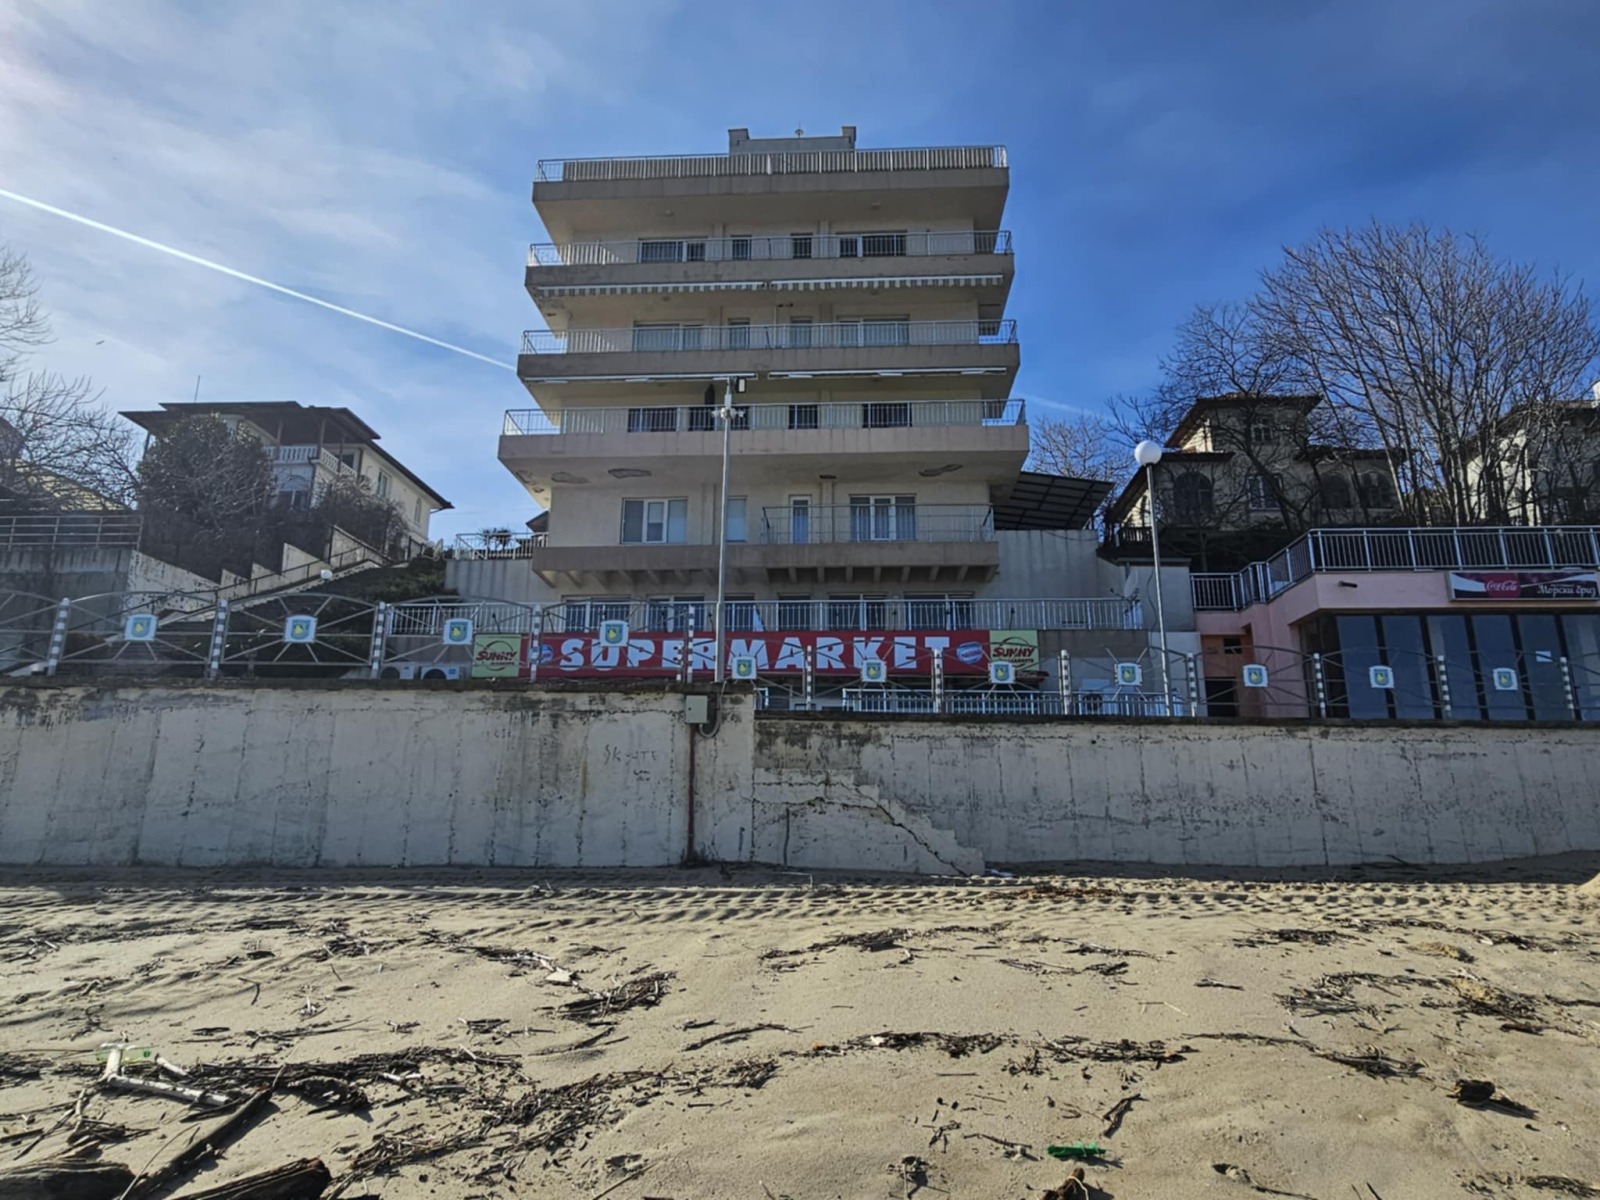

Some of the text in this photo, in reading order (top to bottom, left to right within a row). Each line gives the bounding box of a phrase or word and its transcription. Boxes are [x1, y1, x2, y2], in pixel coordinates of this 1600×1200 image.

[1537, 584, 1574, 598] Морски
[476, 650, 517, 661] SUNNY
[559, 636, 950, 672] SUPERMARKET
[992, 646, 1034, 657] SUNNY
